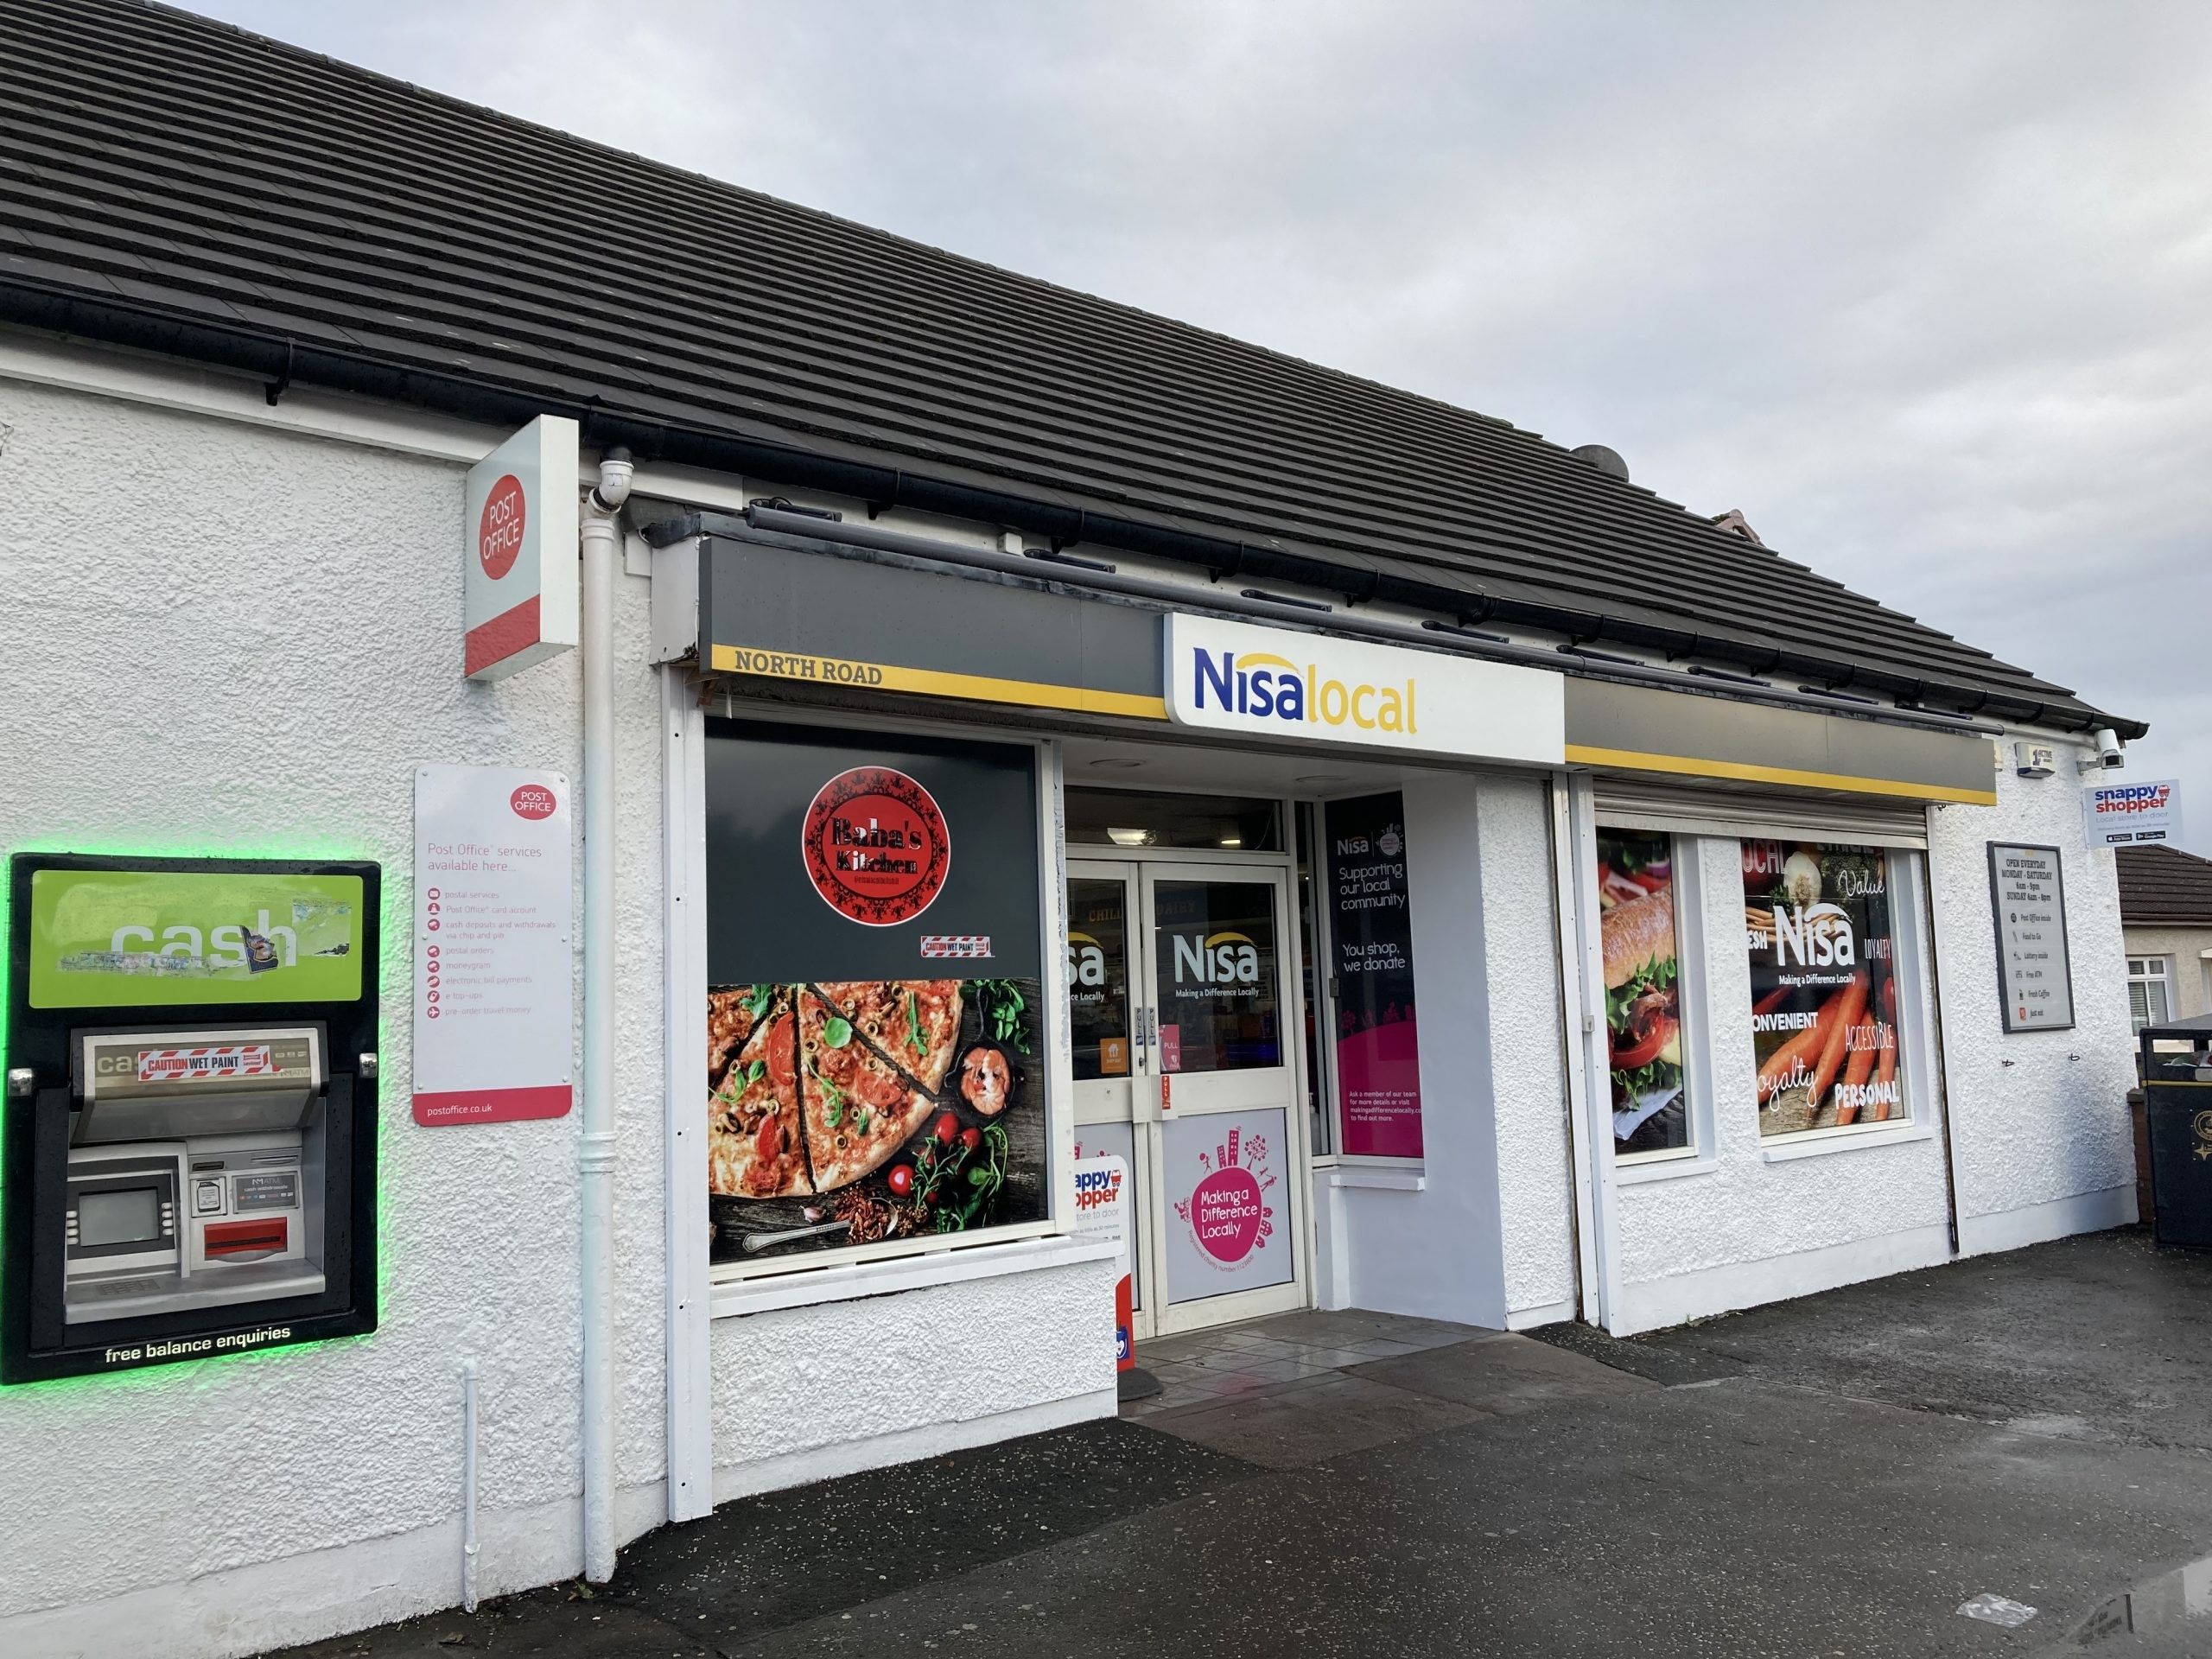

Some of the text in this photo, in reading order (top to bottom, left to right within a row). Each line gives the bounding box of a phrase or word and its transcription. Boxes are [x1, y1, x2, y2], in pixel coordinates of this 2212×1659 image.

[490, 491, 517, 529] POST
[483, 518, 519, 560] OFFICE
[734, 650, 882, 685] NORTH ROAD
[521, 791, 548, 802] POST
[2094, 785, 2158, 801] snappy
[514, 801, 551, 812] OFFICE
[2095, 797, 2168, 814] shopper
[2149, 810, 2169, 819] door
[830, 817, 922, 850] Baba's
[428, 842, 454, 855] Post
[497, 847, 543, 857] services
[1337, 837, 1369, 856] Nisa
[428, 860, 479, 872] available
[836, 850, 918, 874] Kitchen
[2006, 859, 2046, 869] OPEN EVERYDAY
[1339, 863, 1403, 882] Supporting
[2002, 869, 2052, 880] MONDAY SATURDAY
[1340, 879, 1391, 895] our local
[1838, 869, 1885, 897] Value
[445, 891, 467, 899] postal
[1341, 893, 1406, 911] community
[2006, 891, 2026, 900] SUNDAY
[491, 906, 507, 914] card
[2029, 913, 2041, 923] Office
[465, 921, 495, 931] deposits
[111, 909, 297, 969] cash
[459, 931, 474, 941] chip
[493, 932, 505, 941] pin
[1773, 904, 1855, 967] Nisa
[446, 946, 494, 955] postal orders
[925, 942, 947, 951] CAUTION
[947, 942, 957, 951] WET
[959, 943, 974, 951] PAINT
[1342, 943, 1365, 957] You
[1864, 938, 1891, 959] LOYALTY
[1173, 932, 1259, 983] Nisa
[1344, 957, 1406, 972] we donate
[446, 962, 491, 970] moneygram
[497, 976, 532, 985] payments
[1779, 974, 1802, 987] Making
[1806, 974, 1836, 985] Difference
[1836, 972, 1856, 986] Locally
[1080, 993, 1105, 1002] Locally
[1175, 988, 1199, 1000] Making
[1205, 988, 1237, 998] Difference
[1237, 988, 1260, 998] Locally
[1753, 1011, 1819, 1032] ONVENIENT
[1845, 1020, 1894, 1052] ACCESSIBLE
[148, 1058, 188, 1072] CAUTION
[188, 1057, 208, 1070] WET
[211, 1055, 239, 1069] PAINT
[1757, 1055, 1819, 1112] oyalty
[1834, 1080, 1900, 1110] PERSONAL
[427, 1103, 493, 1117] postoffice.co.uk
[1200, 1189, 1249, 1206] Making a
[1093, 1210, 1101, 1219] to
[1102, 1208, 1120, 1217] door
[1201, 1205, 1258, 1223] Difference
[1202, 1222, 1242, 1239] Locally
[105, 1326, 290, 1363] free balance enquiries
